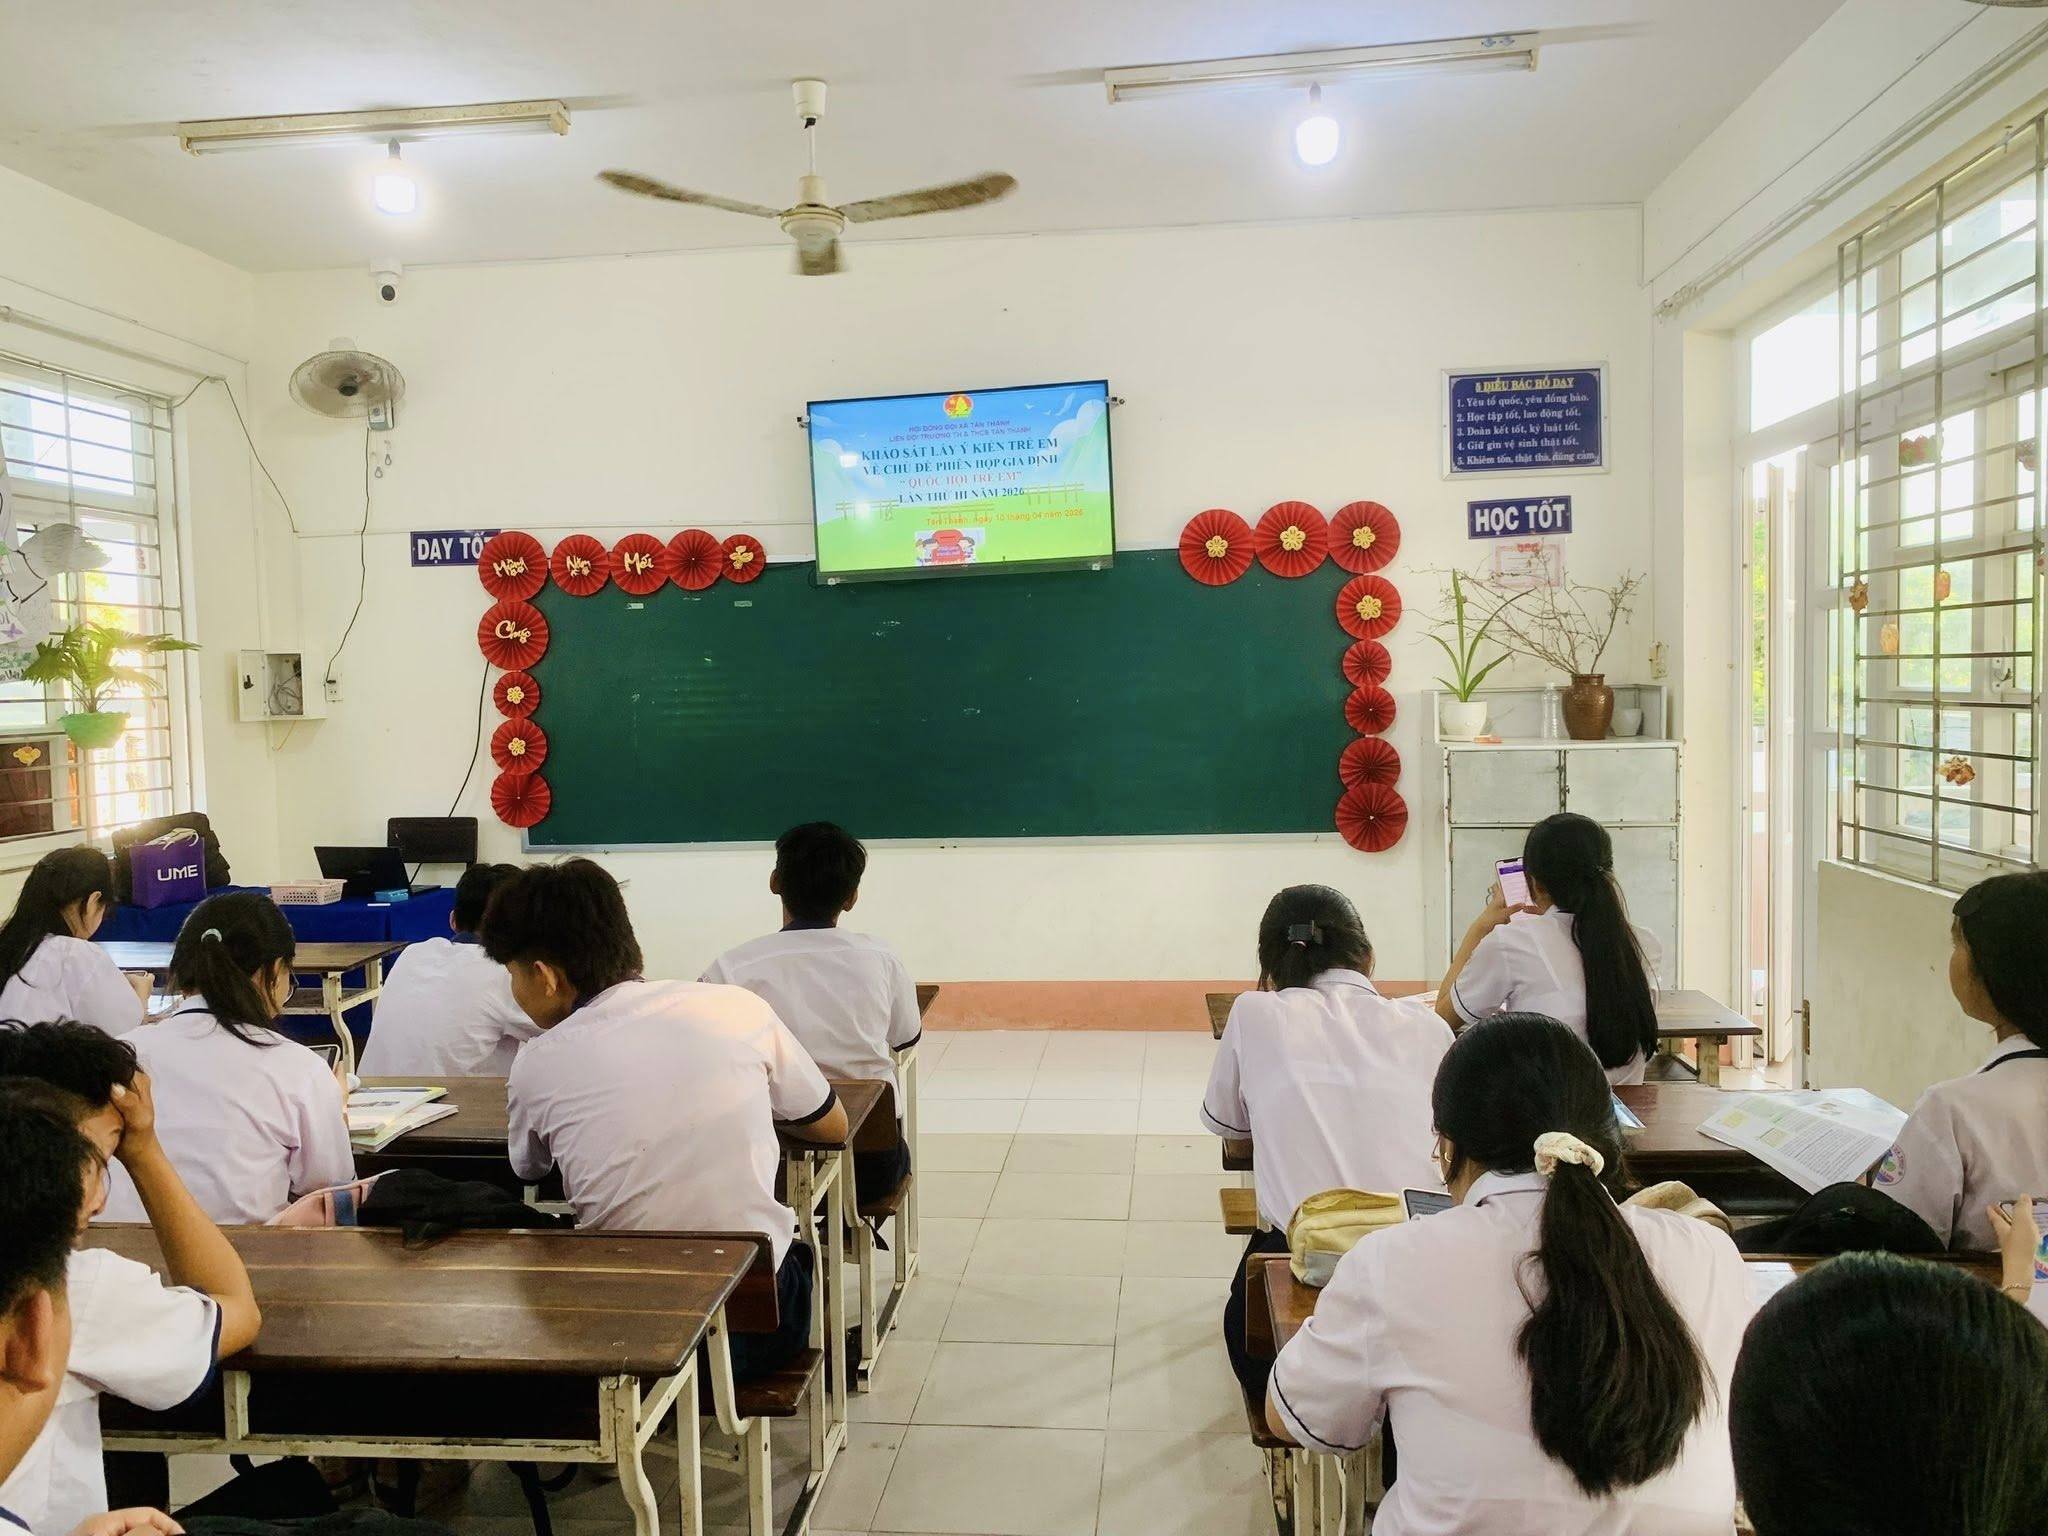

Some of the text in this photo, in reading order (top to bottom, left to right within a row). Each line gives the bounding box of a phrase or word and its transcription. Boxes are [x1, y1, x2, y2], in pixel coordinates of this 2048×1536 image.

[1457, 399, 1464, 408] 1.
[1466, 397, 1484, 407] Yêu
[1525, 395, 1542, 406] yêu
[1457, 413, 1465, 422] 2.
[1467, 412, 1485, 423] Học
[1487, 411, 1503, 423] tập
[1523, 410, 1537, 419] lao
[1540, 409, 1563, 419] động
[1565, 406, 1581, 416] tốt.
[1457, 427, 1465, 437] 3.
[1467, 426, 1491, 436] Đoàn
[1493, 424, 1509, 435] kết
[1543, 423, 1562, 433] luật
[1564, 421, 1581, 431] tốt.
[903, 445, 927, 458] SÁT
[931, 442, 955, 457] LẤY
[960, 441, 967, 454] Ý
[973, 439, 1004, 453] KIẾN
[1038, 438, 1058, 449] EM
[1457, 435, 1579, 451] 4. Giữ gìn vệ sinh thật tốt.
[1457, 456, 1465, 465] 5.
[1467, 455, 1495, 465] Khiêm
[1515, 453, 1532, 464] thật
[971, 487, 998, 499] NĂM
[1002, 487, 1025, 497] 2026
[1475, 498, 1565, 535] HỌC TỐT
[417, 531, 493, 564] DẠY TỐ
[157, 864, 199, 882] UME
